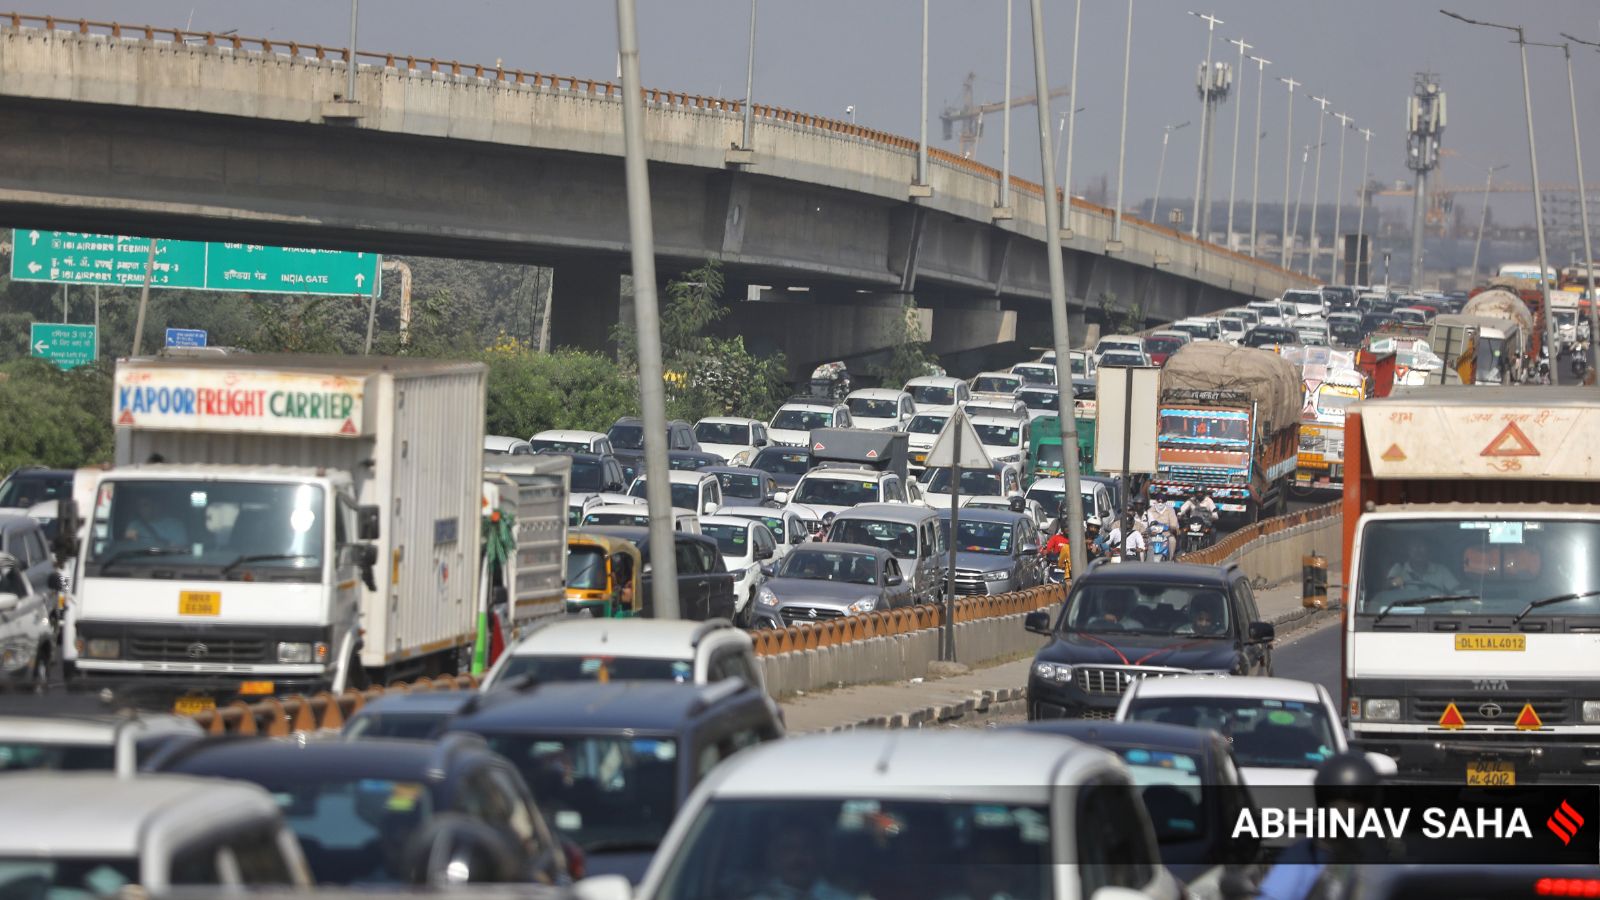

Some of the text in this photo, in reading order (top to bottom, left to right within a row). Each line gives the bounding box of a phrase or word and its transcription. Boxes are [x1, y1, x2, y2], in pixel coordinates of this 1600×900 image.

[75, 271, 112, 280] AIRPORT
[281, 274, 328, 283] INDIA GATE
[118, 386, 354, 419] KAPOOR FREIGHT CARRIER
[1471, 679, 1509, 690] TATA
